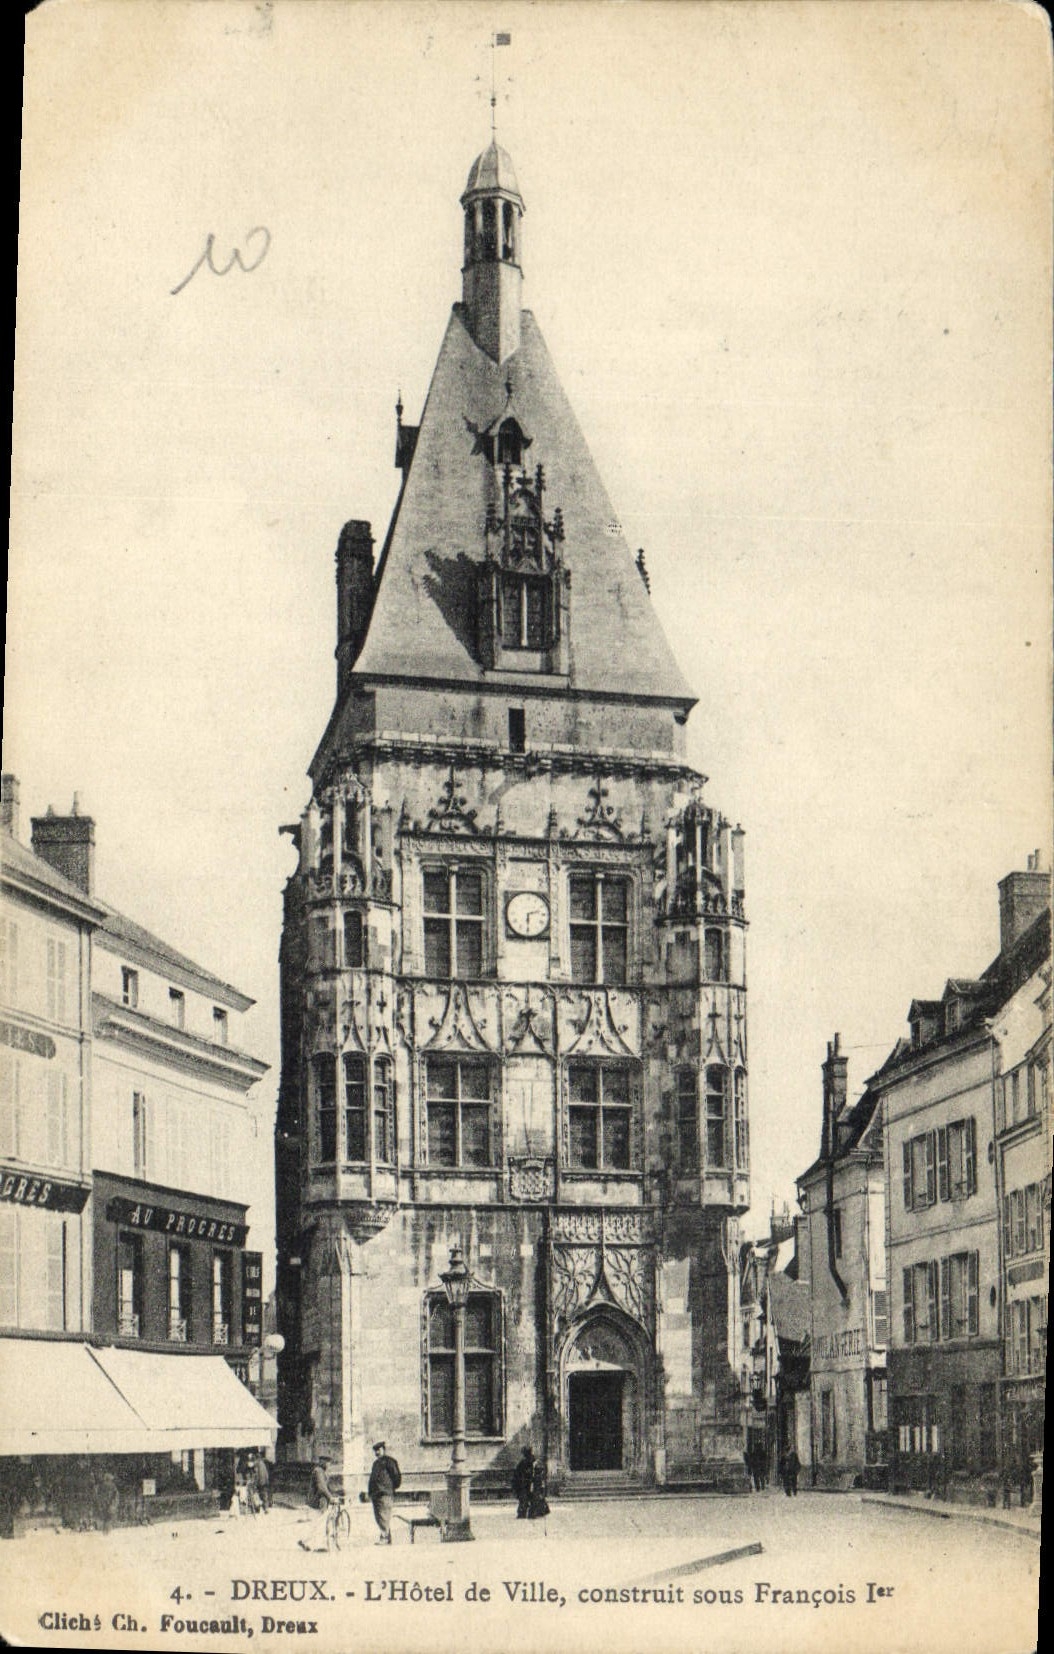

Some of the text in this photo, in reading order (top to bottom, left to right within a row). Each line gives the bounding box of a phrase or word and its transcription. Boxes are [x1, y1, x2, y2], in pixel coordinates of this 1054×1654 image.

[0, 1173, 52, 1203] GRES
[131, 1205, 236, 1242] AU PROGRES
